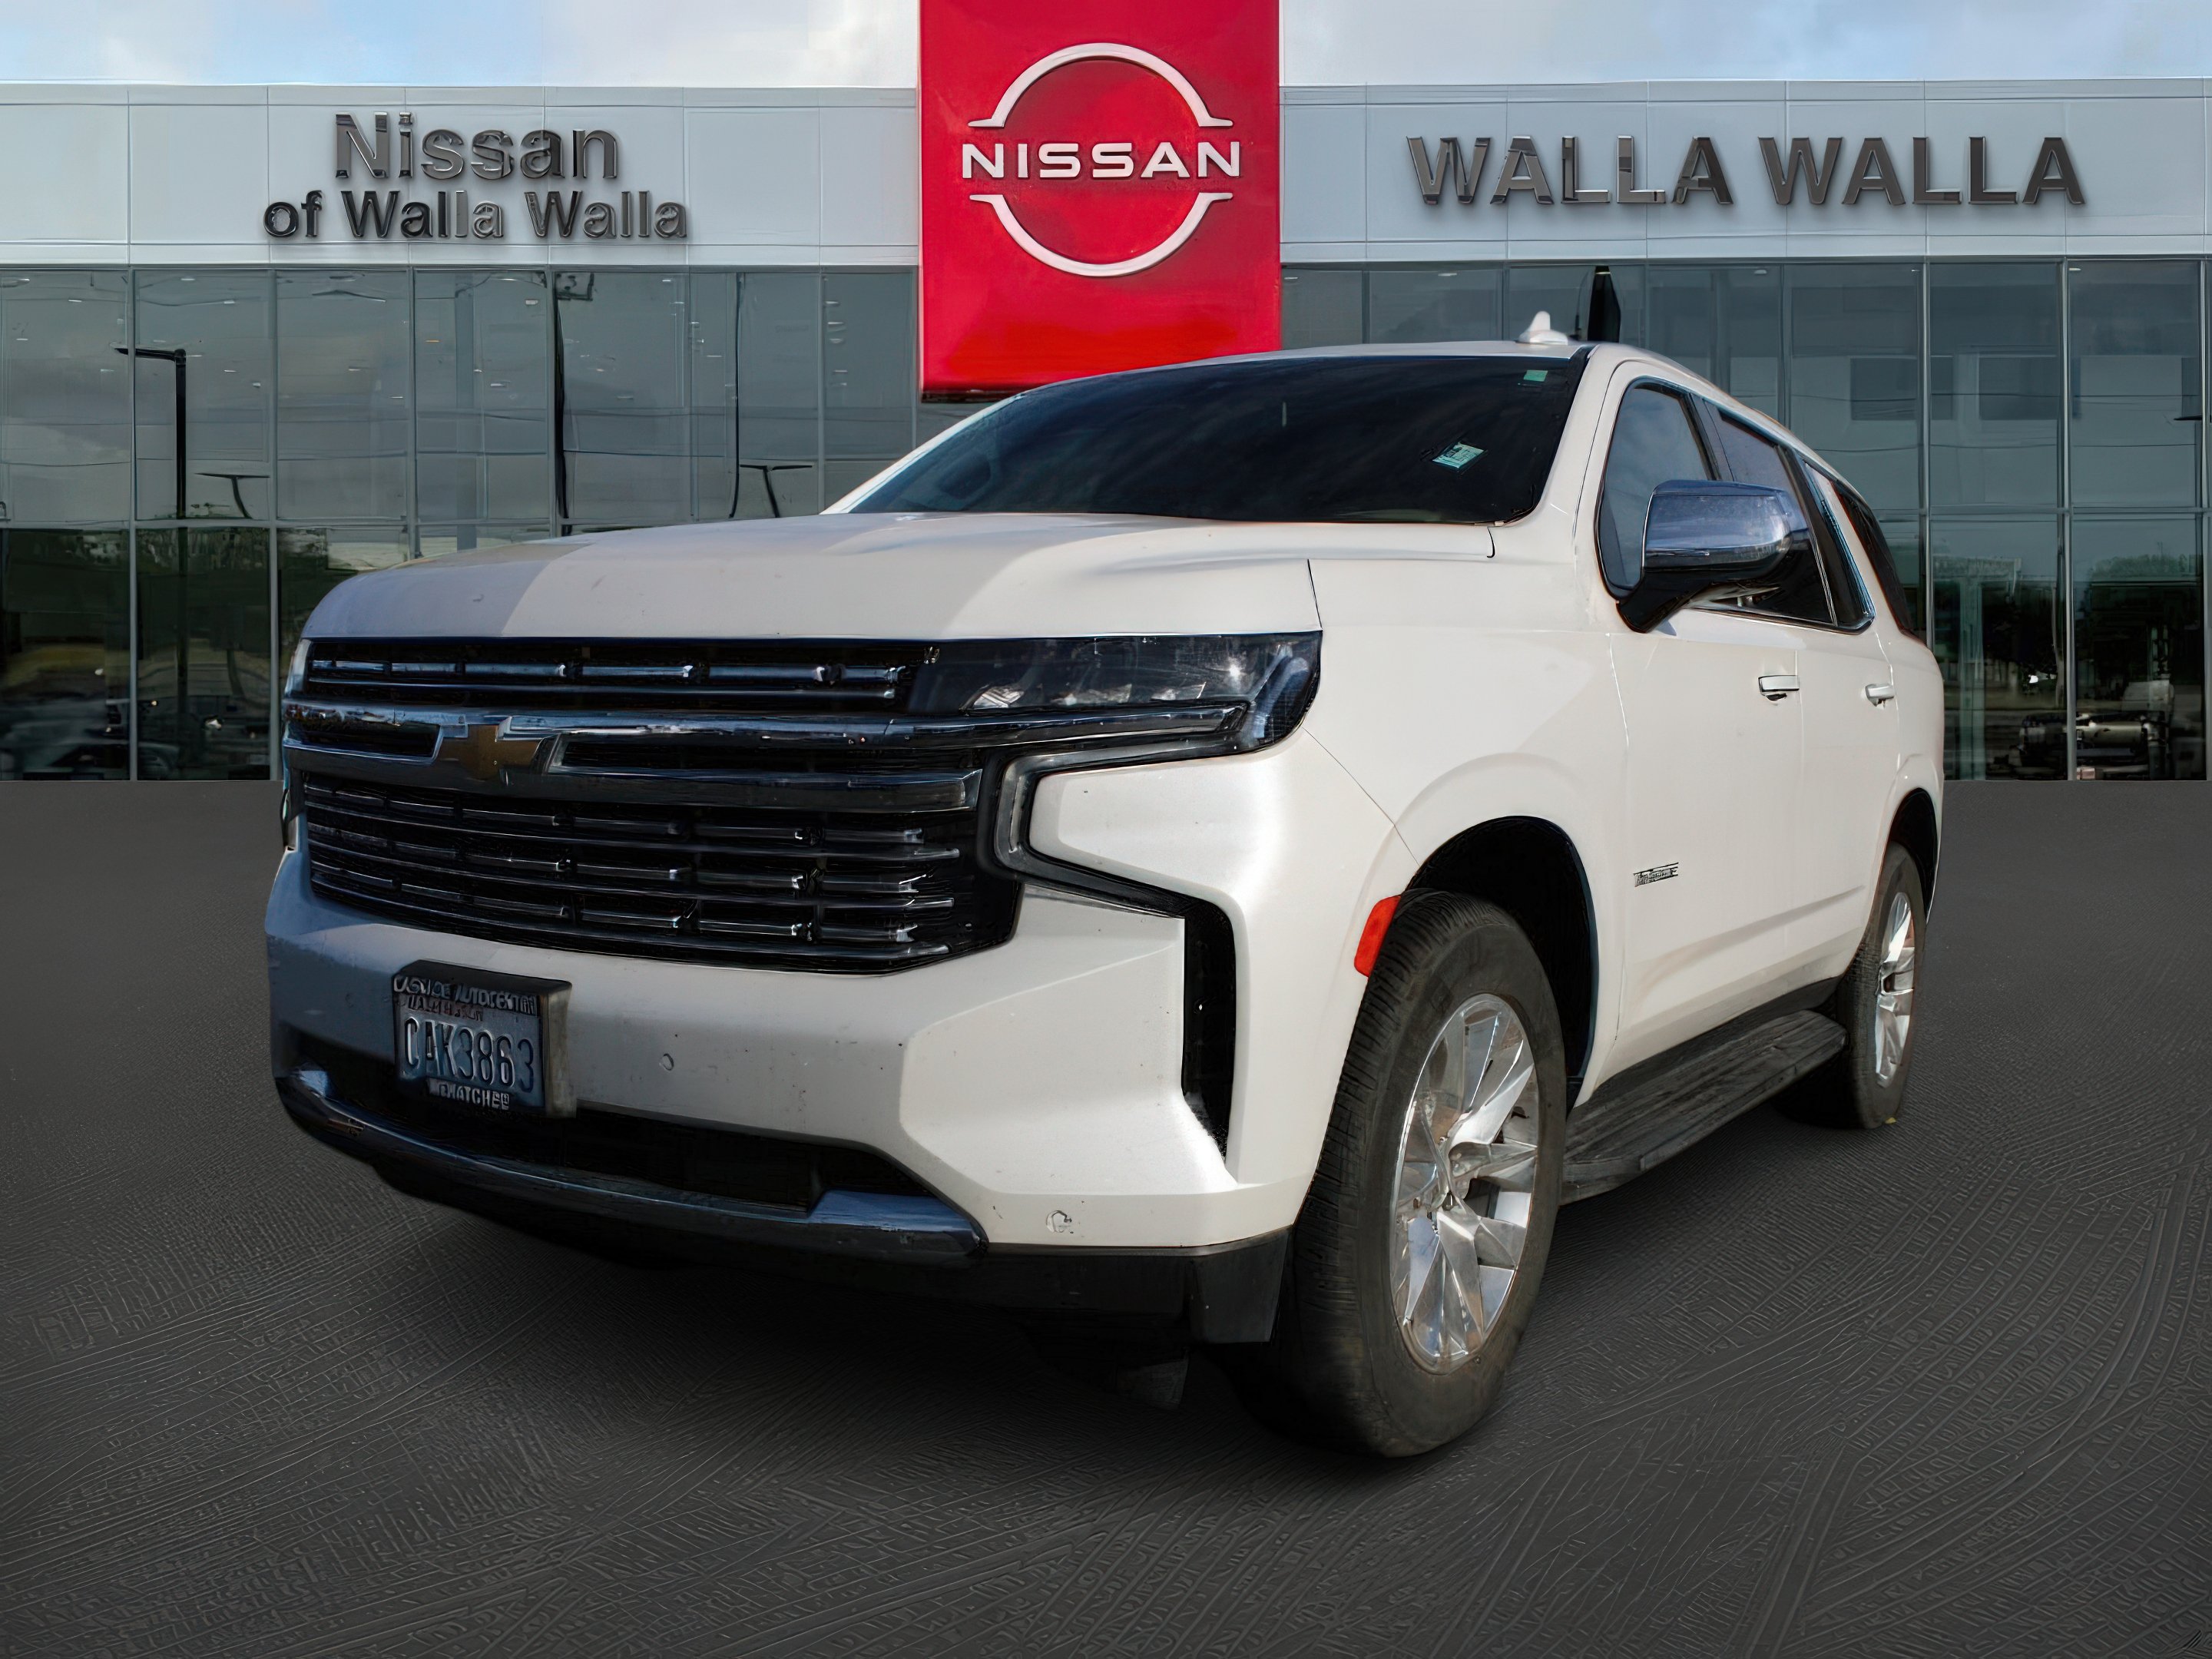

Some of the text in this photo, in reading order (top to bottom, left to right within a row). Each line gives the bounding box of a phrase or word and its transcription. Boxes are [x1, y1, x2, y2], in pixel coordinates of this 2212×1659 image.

[334, 111, 618, 181] Nissan
[962, 141, 1240, 179] NISSAN
[1406, 135, 2086, 206] WALLA WALLA
[262, 189, 687, 239] of Walla Walla
